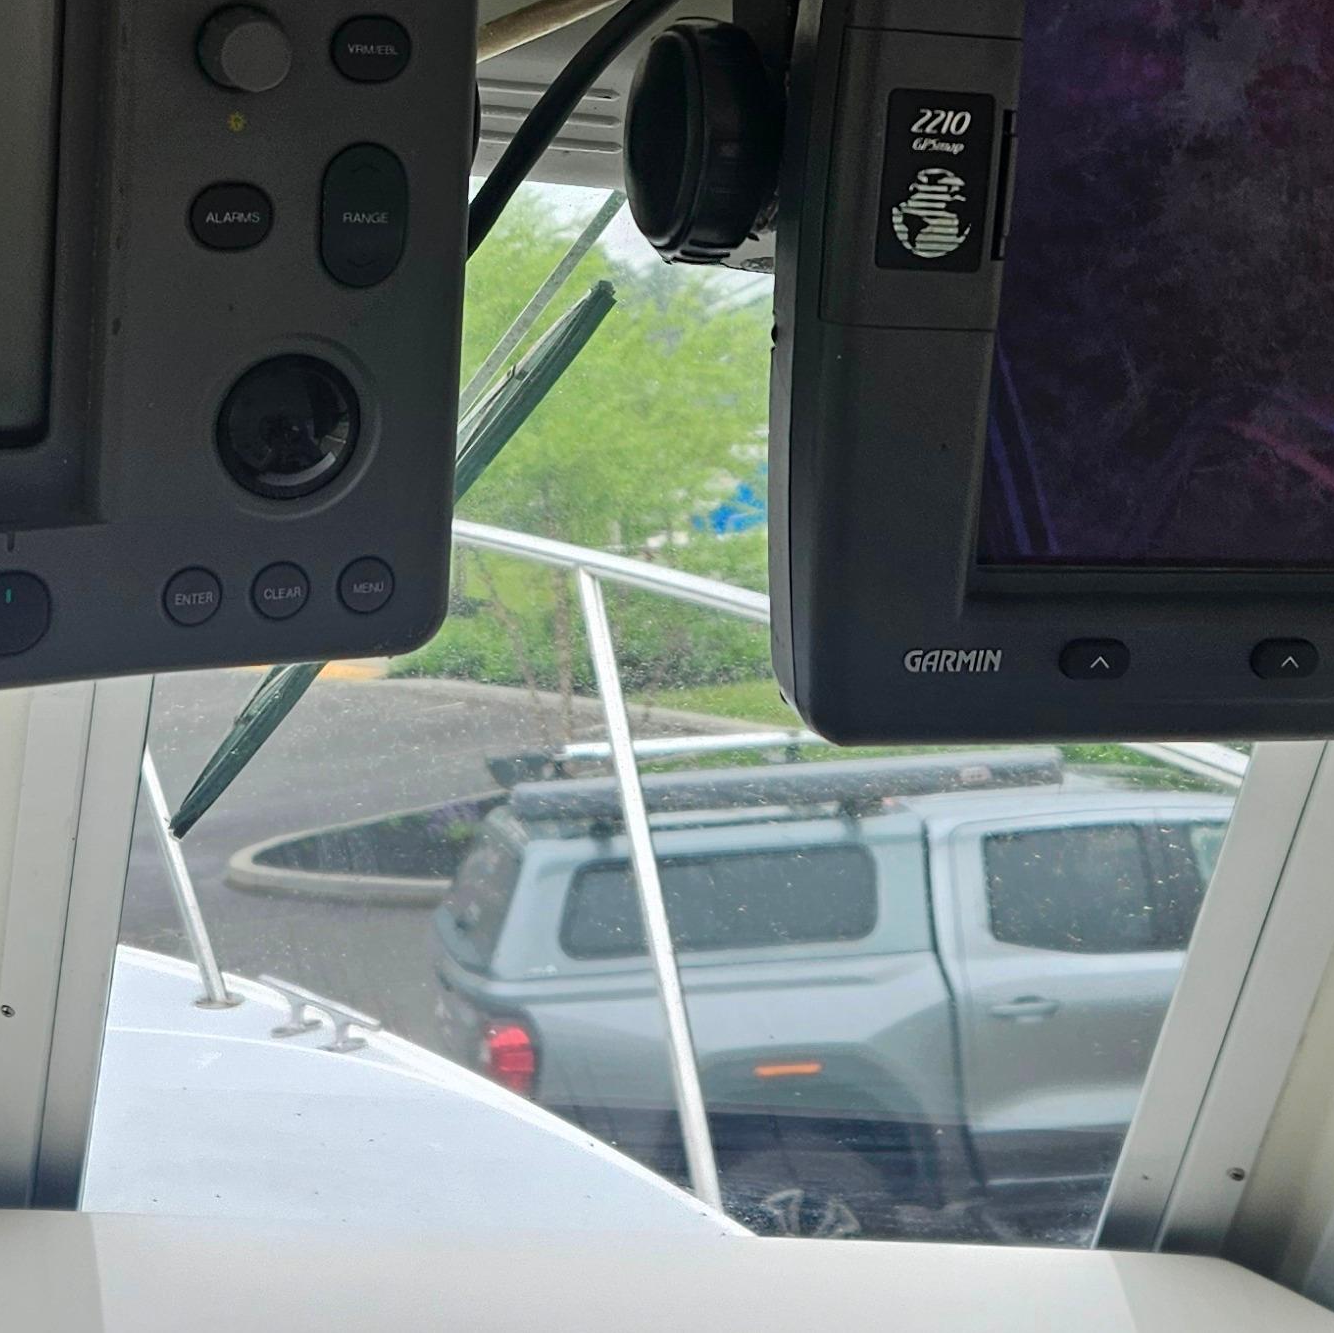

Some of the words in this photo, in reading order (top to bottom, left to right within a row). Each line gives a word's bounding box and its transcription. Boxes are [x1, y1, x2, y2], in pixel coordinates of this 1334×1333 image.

[910, 109, 971, 135] 2210
[912, 137, 965, 154] GPSmap
[205, 210, 260, 224] ALARMS
[342, 211, 389, 225] RANGE
[263, 585, 302, 600] CLEAR
[352, 581, 384, 595] MENU
[175, 591, 213, 606] ENTER
[904, 649, 1002, 672] GARMIN
